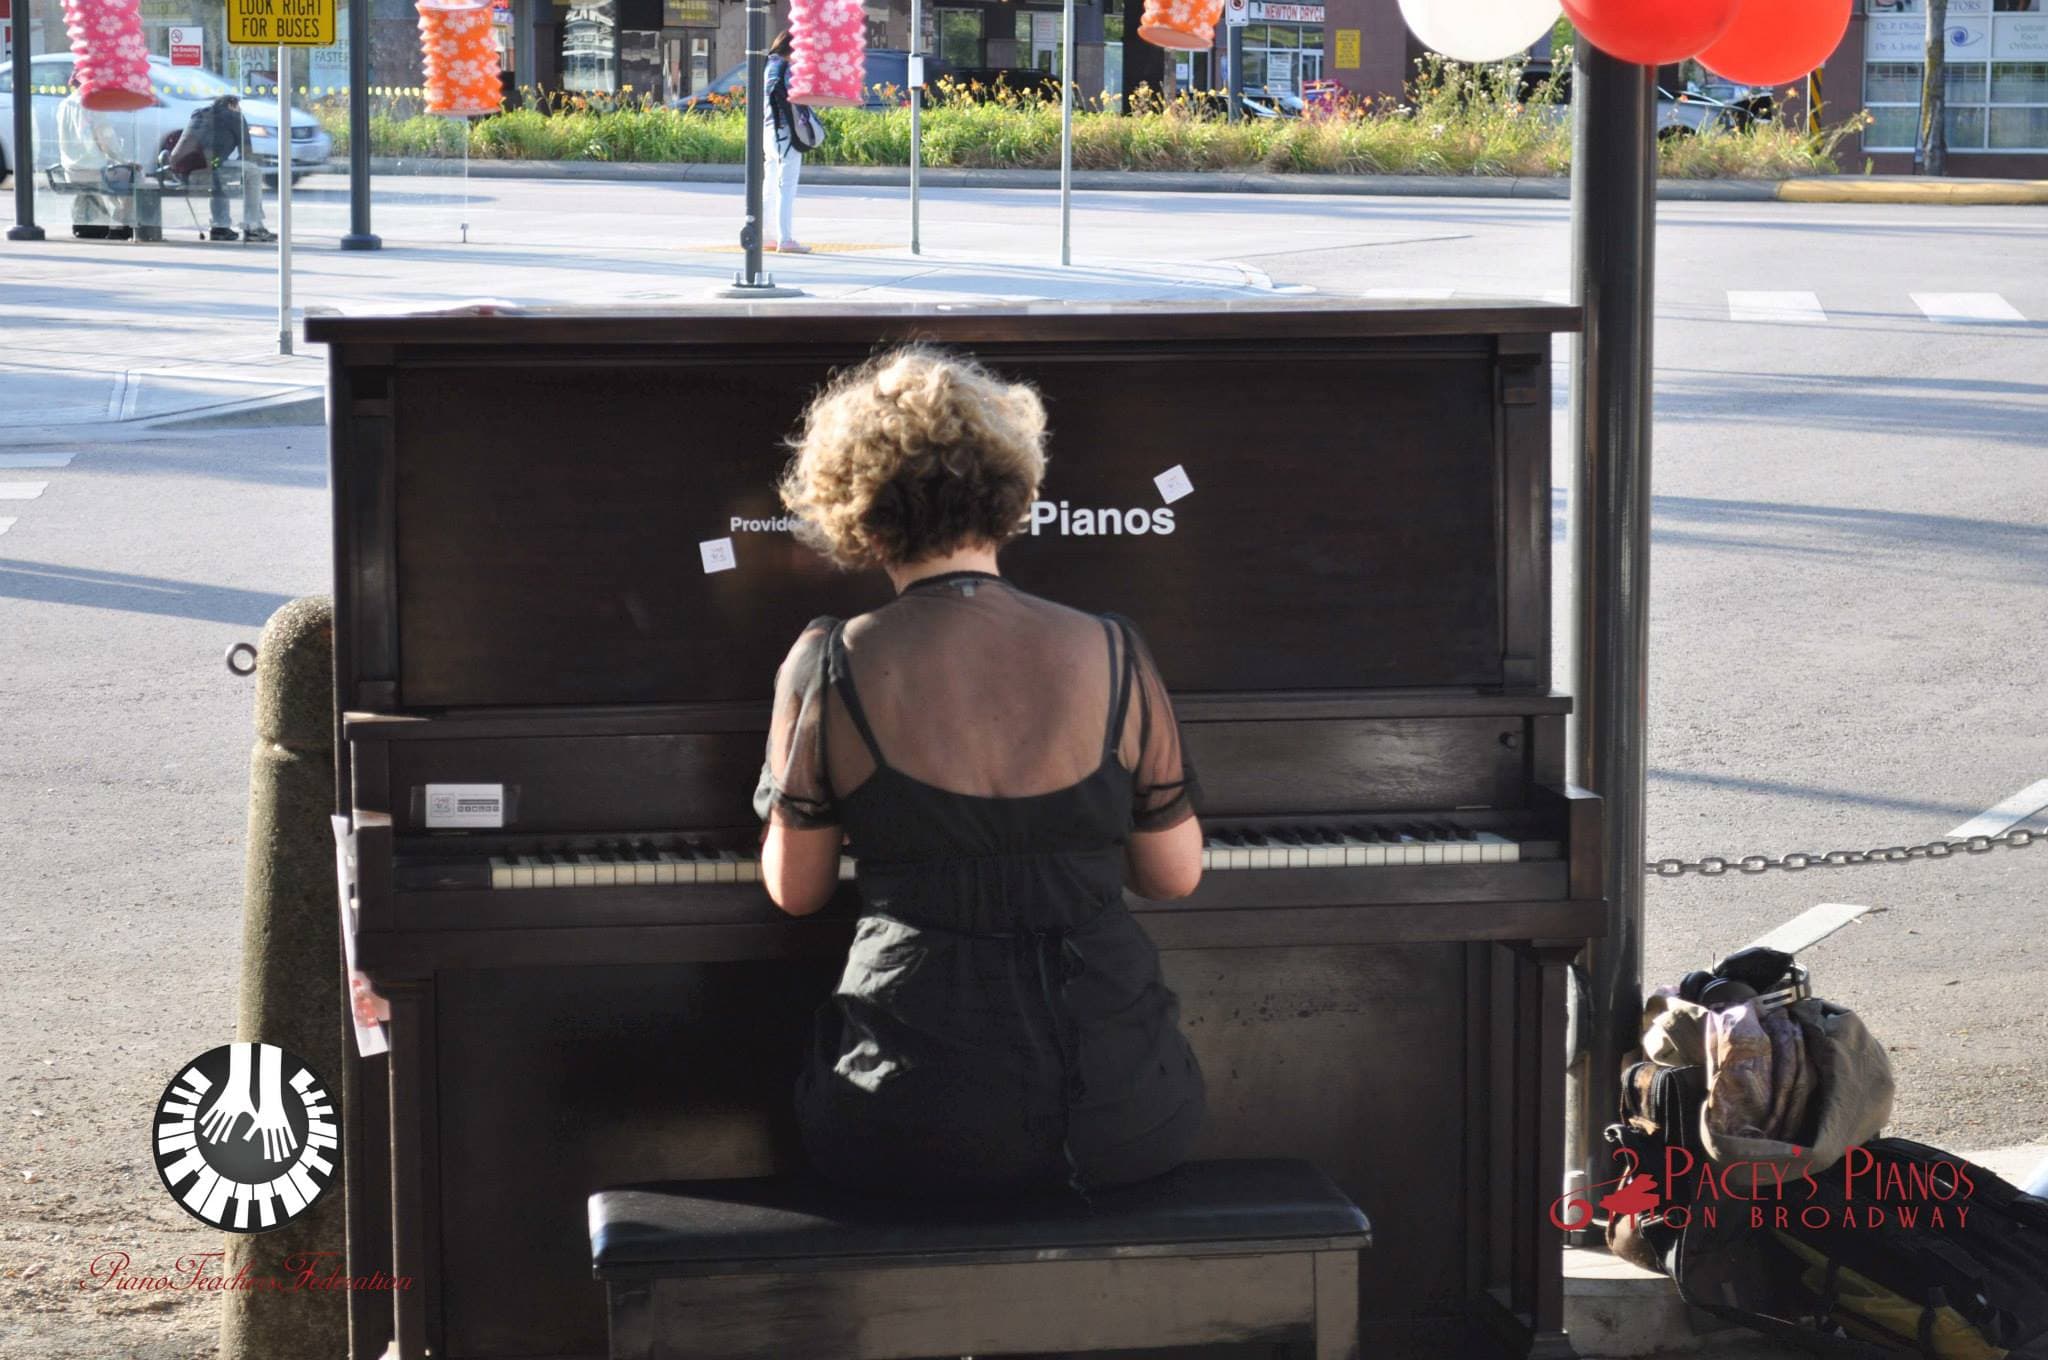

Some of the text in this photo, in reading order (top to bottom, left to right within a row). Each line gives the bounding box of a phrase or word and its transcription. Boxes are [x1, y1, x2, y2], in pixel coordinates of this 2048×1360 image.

[240, 0, 320, 15] LOOK RIGHT
[1264, 4, 1297, 19] NEWTON
[242, 18, 319, 37] FOR BUSES
[1029, 502, 1175, 536] Pianos
